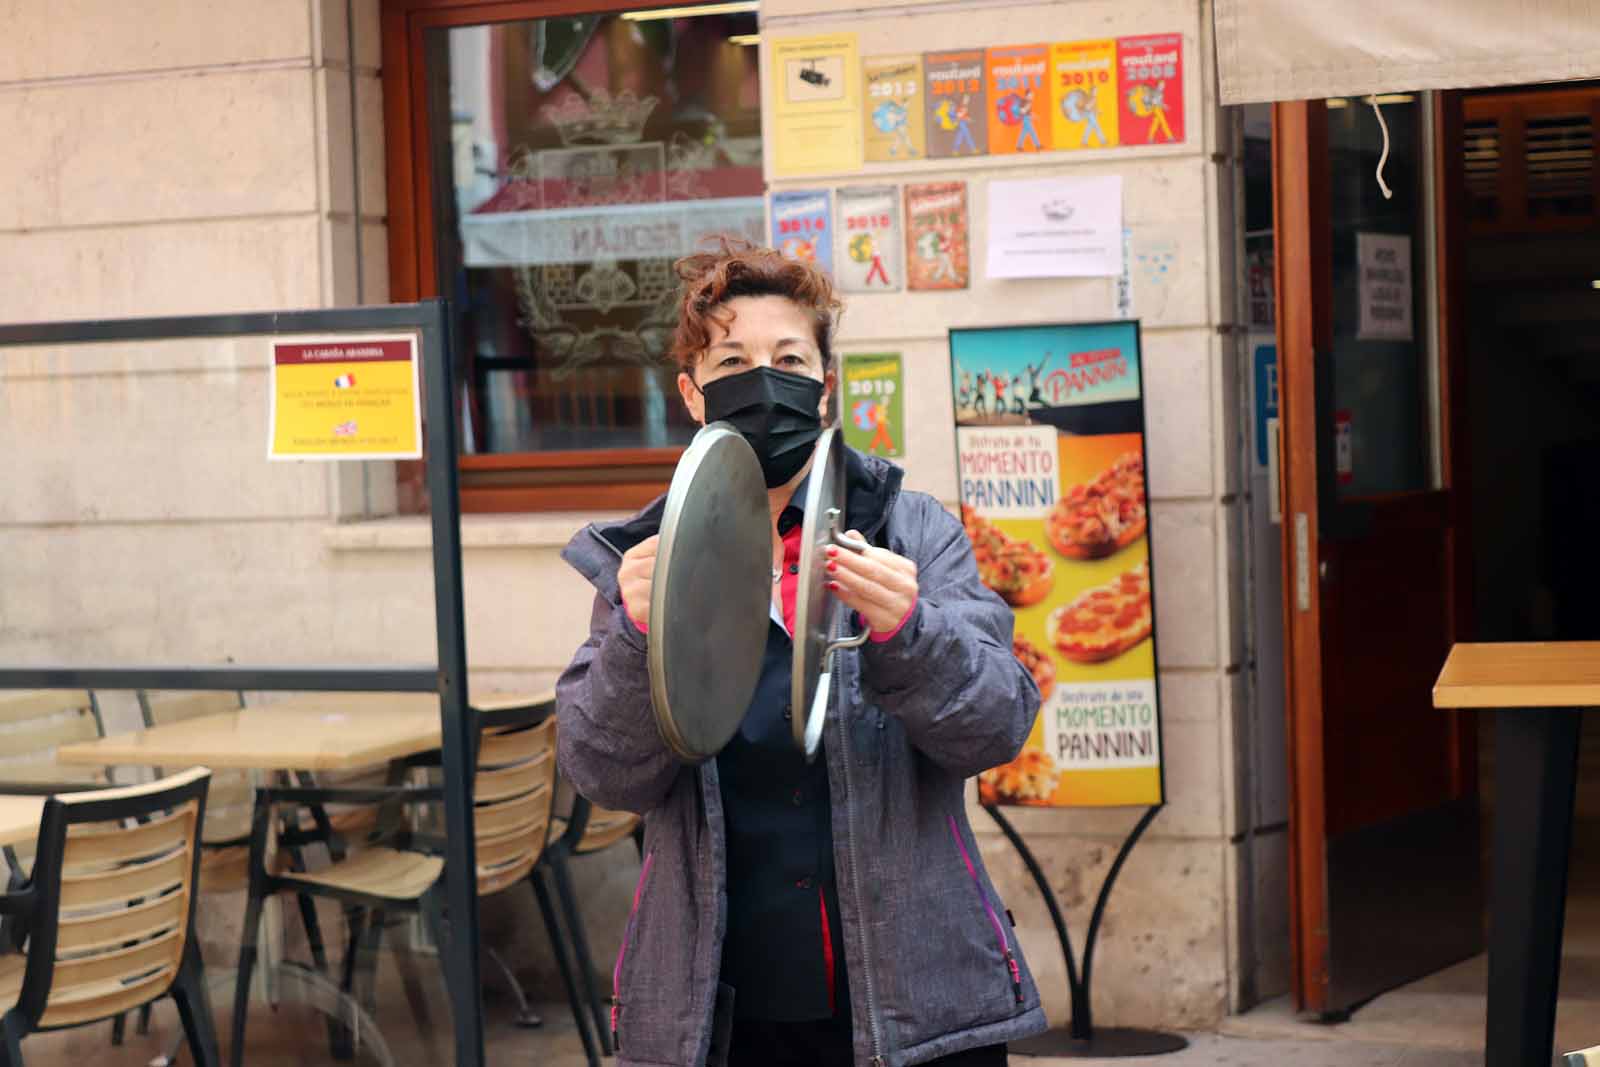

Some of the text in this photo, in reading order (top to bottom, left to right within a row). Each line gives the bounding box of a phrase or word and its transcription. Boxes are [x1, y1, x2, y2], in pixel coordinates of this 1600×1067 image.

[1061, 71, 1109, 87] 2010
[961, 450, 1052, 473] MOMENTO
[963, 478, 1054, 507] PANNINI
[1057, 704, 1152, 727] MOMENTO
[1058, 731, 1153, 758] PANNINI
